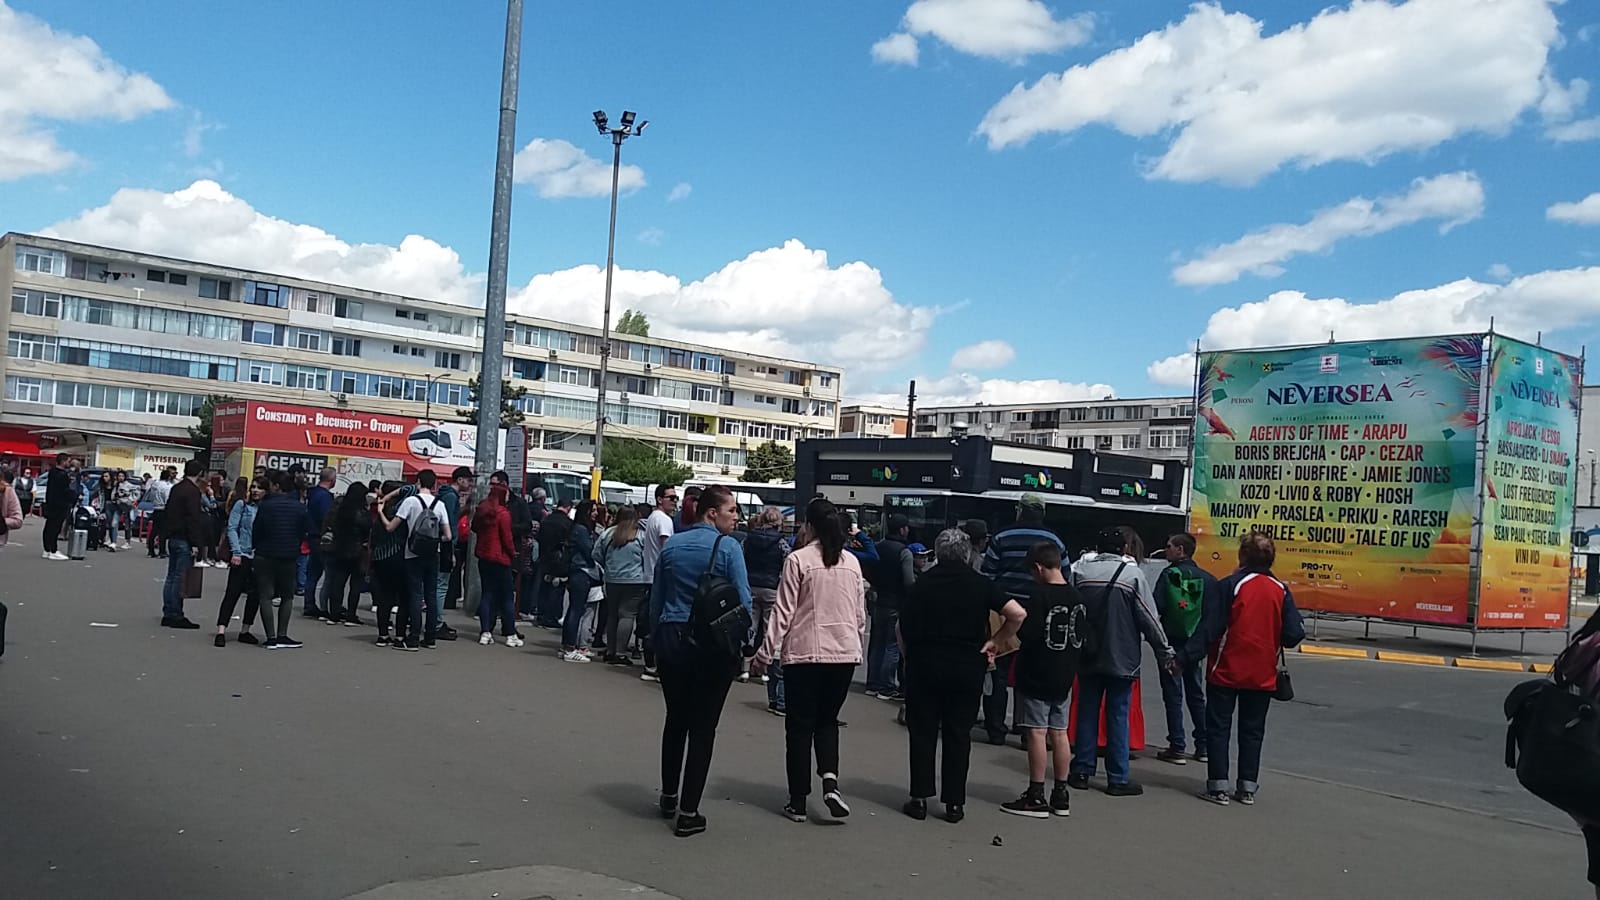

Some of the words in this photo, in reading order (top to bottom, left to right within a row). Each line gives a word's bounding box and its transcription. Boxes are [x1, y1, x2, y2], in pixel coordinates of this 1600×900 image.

[1267, 383, 1393, 406] NEVERSEA
[1510, 380, 1560, 408] NEVERSEA
[369, 418, 404, 434] OTOPENI
[1249, 425, 1296, 441] AGENTS
[1299, 424, 1314, 441] OF
[1317, 424, 1350, 441] TIME
[1362, 423, 1408, 441] ARAPU
[331, 434, 391, 450] 0744.22.66.11
[1235, 445, 1269, 460] BORIS
[1273, 445, 1327, 461] BREJCHA
[1340, 445, 1366, 461] CAP
[1379, 445, 1424, 462] CEZAR
[1212, 464, 1236, 479] DAN
[1239, 464, 1282, 480] ANDREI
[1295, 465, 1347, 481] DUBFIRE
[1361, 466, 1402, 482] JAMIE
[1406, 466, 1451, 483] JONES
[1240, 484, 1270, 500] KOZO
[1280, 485, 1310, 501] LIVIO
[1313, 485, 1322, 502] &
[1326, 486, 1362, 503] ROBY
[1376, 487, 1413, 504] HOSH
[1503, 483, 1518, 500] LOST
[1210, 503, 1261, 519] MAHONY
[1272, 505, 1324, 522] PRASLEA
[1338, 507, 1378, 524] PRIKU
[1392, 509, 1448, 527] RARESH
[1220, 522, 1239, 538] SIT
[1307, 526, 1345, 543] SUCIU
[1355, 528, 1387, 546] TALE
[1390, 530, 1408, 547] OF
[1412, 531, 1431, 549] US
[1493, 524, 1510, 541] SEAN
[1510, 526, 1526, 543] PAUL
